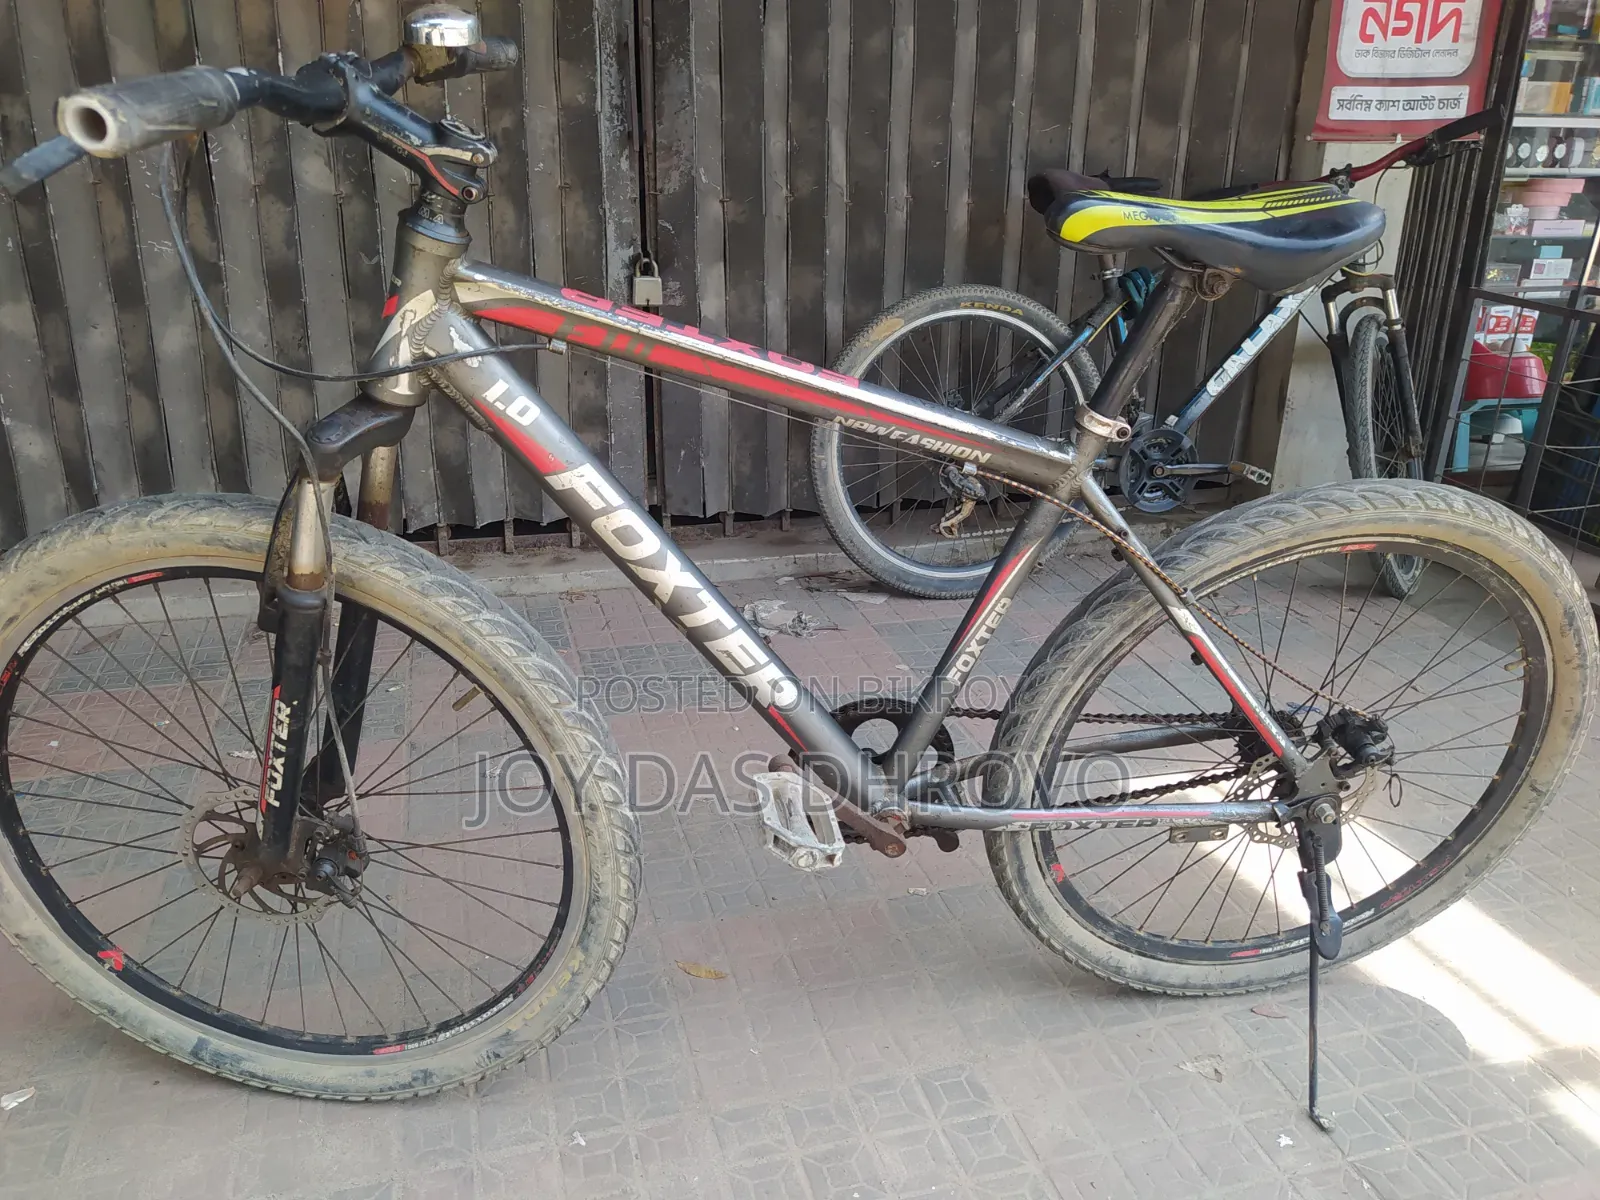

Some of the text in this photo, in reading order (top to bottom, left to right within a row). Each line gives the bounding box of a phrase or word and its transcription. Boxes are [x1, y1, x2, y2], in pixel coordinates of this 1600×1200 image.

[1375, 98, 1401, 111] ক্যাশ
[1402, 96, 1436, 111] আউট
[1437, 92, 1465, 110] চার্জ
[959, 301, 1024, 316] KENDA
[544, 463, 798, 708] FOXTER
[946, 597, 1012, 687] FOXTER
[264, 699, 292, 808] FOXTER
